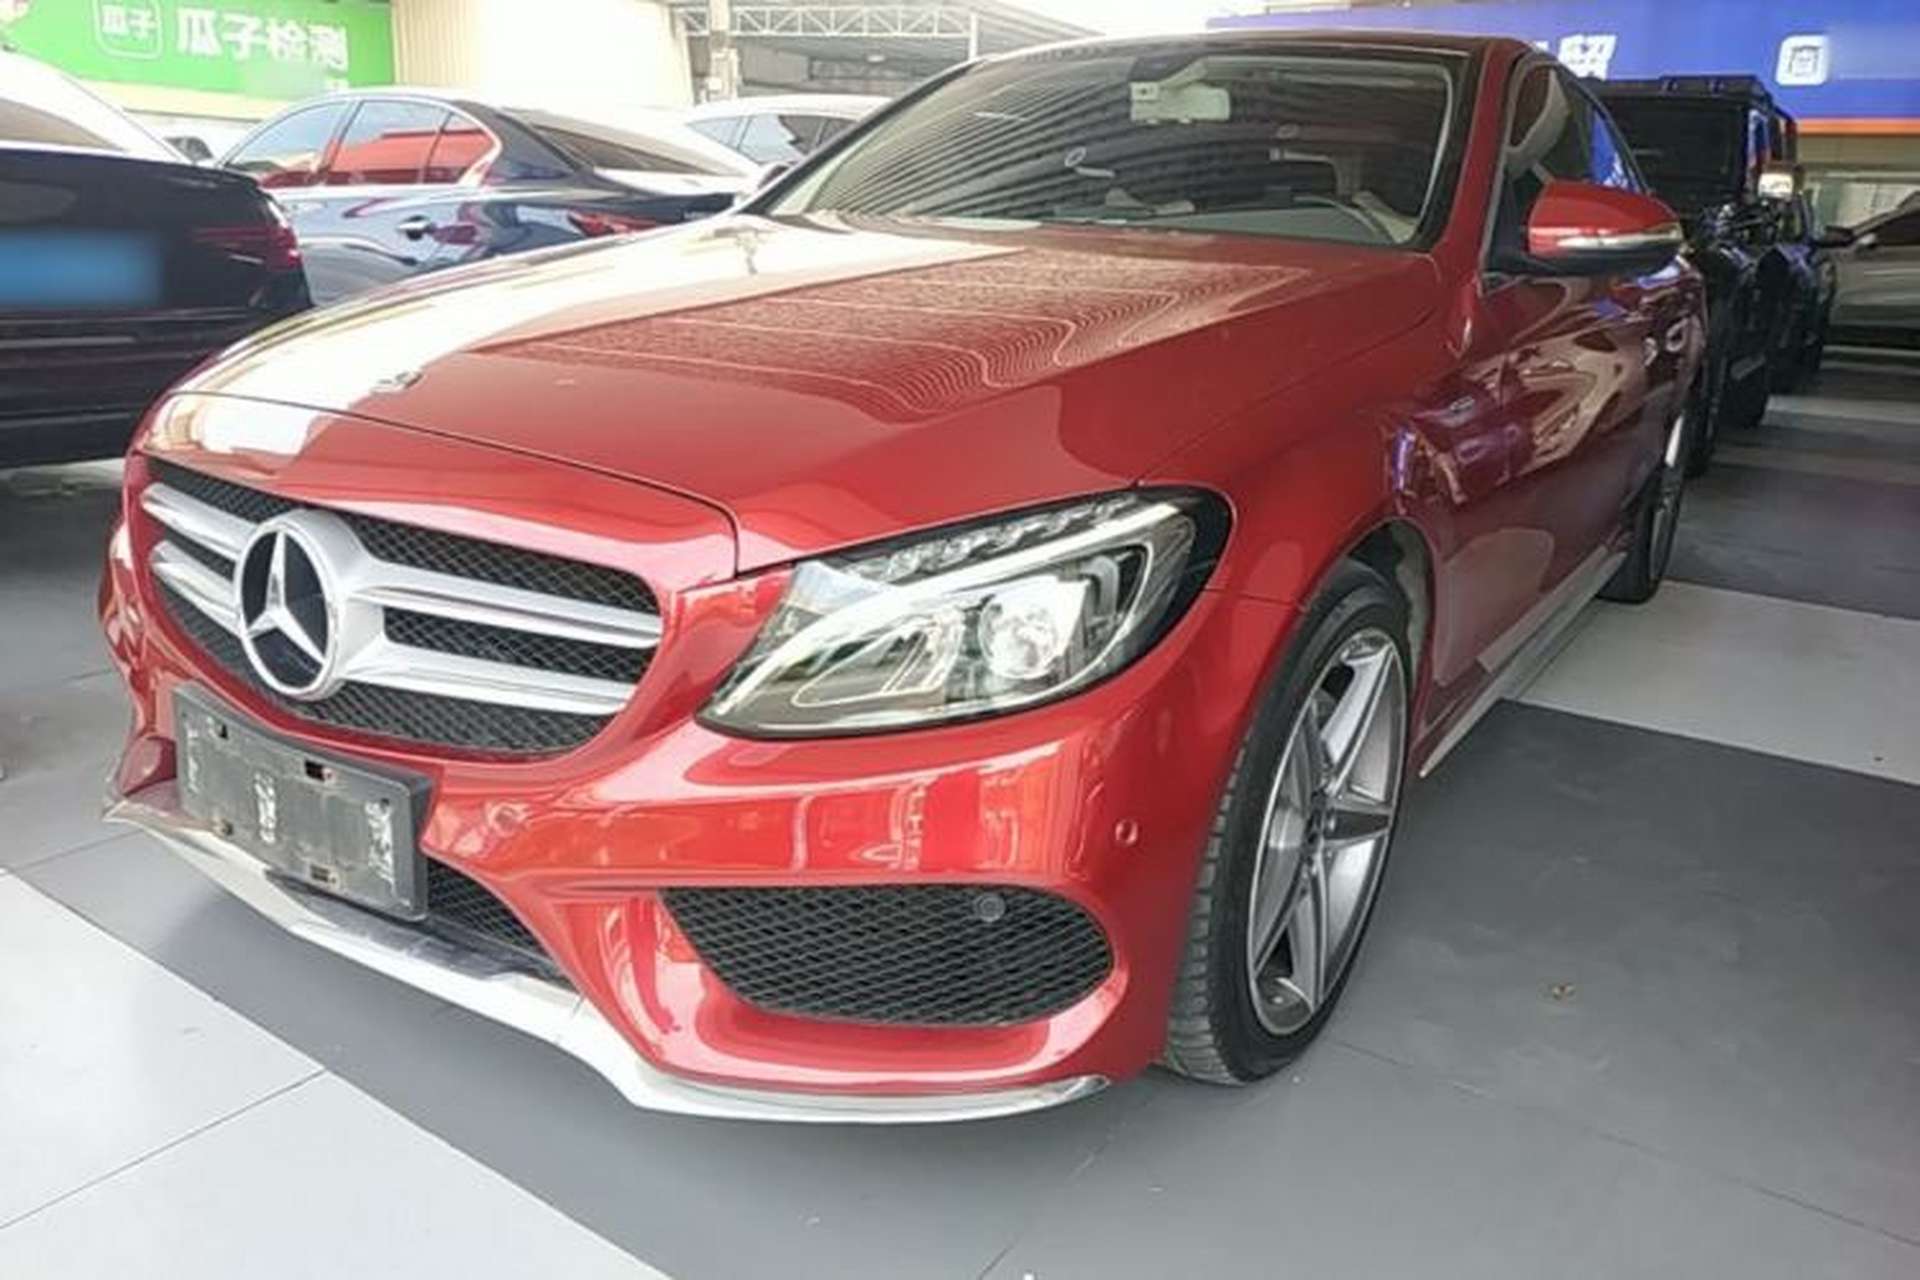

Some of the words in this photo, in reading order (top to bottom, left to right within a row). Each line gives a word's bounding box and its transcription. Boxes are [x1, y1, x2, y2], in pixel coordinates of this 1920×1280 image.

[177, 7, 350, 71] 瓜子检测
[1536, 33, 1617, 81] 贸
